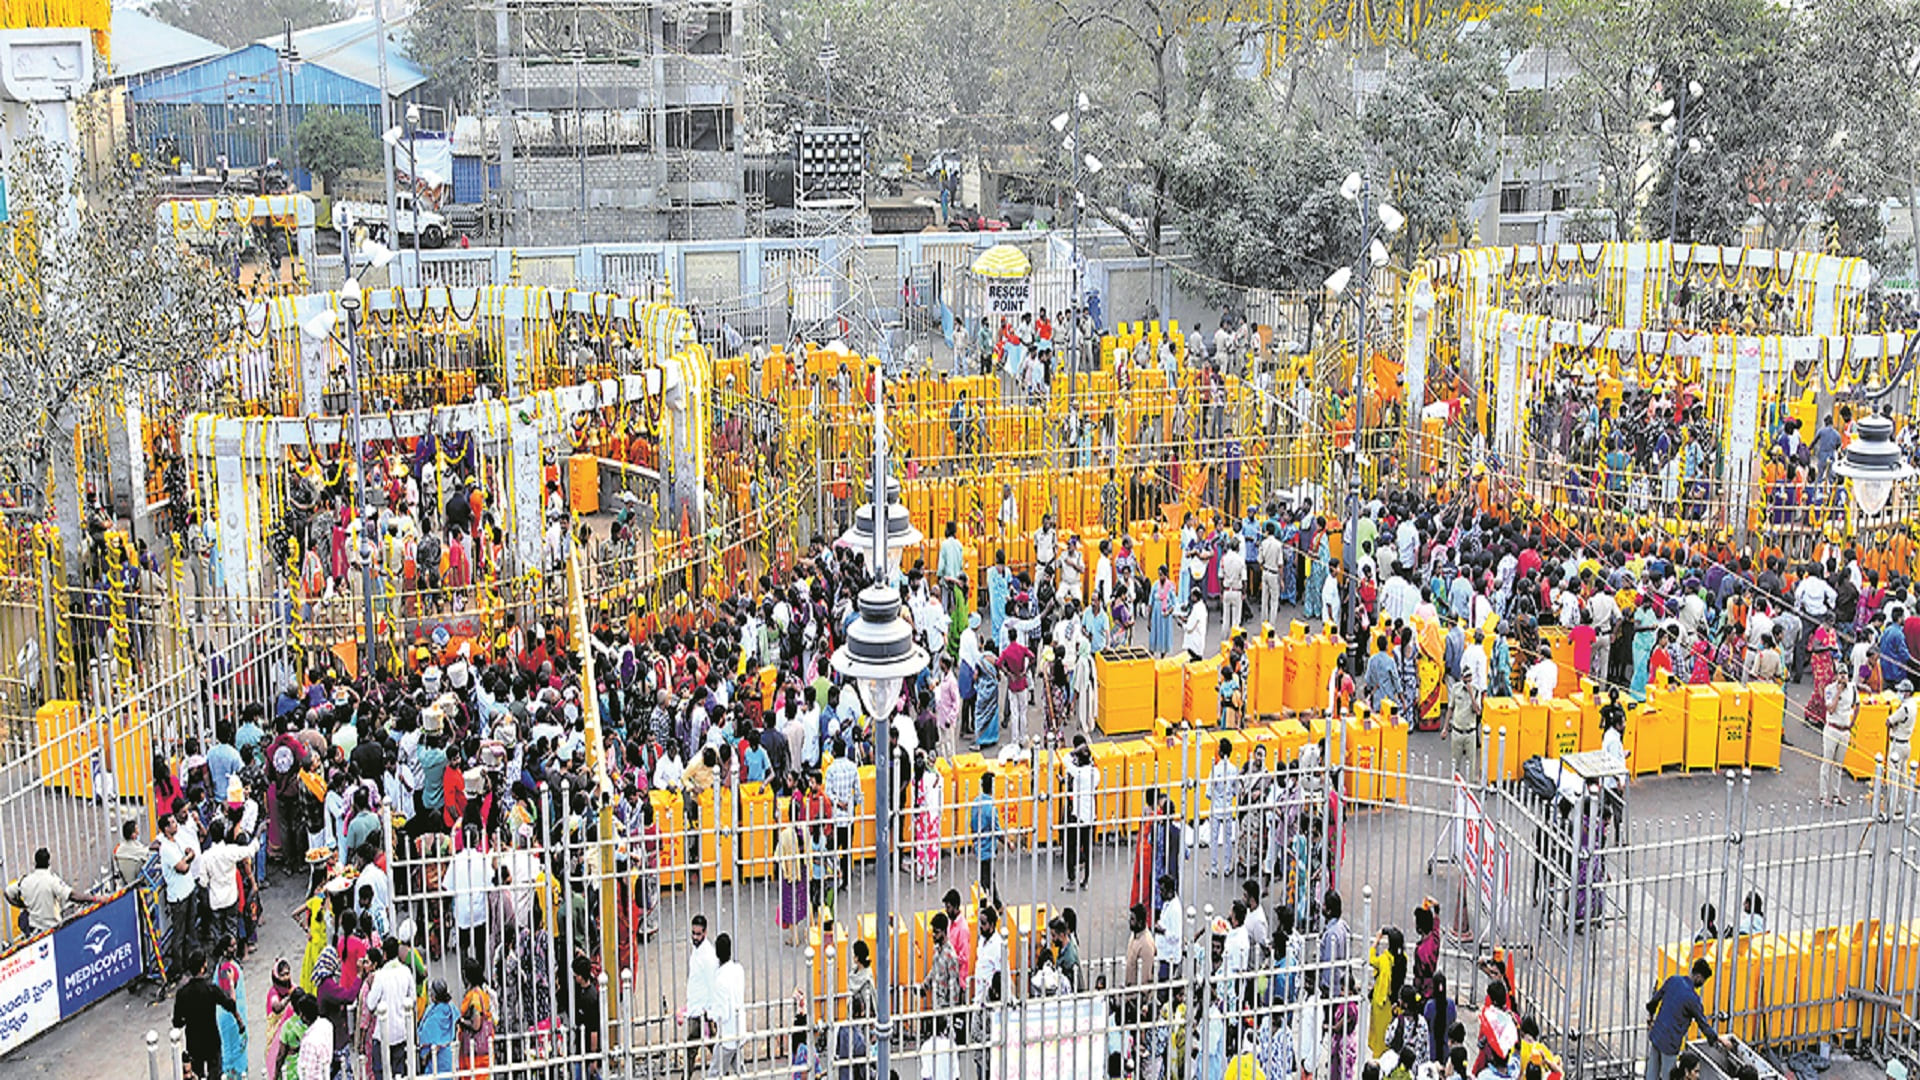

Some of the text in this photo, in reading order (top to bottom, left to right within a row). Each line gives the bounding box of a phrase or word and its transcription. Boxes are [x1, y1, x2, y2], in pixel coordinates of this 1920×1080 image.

[988, 285, 1030, 298] RESCUE
[992, 299, 1025, 312] POINT
[64, 942, 132, 990] MEDICOVER
[65, 958, 133, 1001] HOSPITALS
